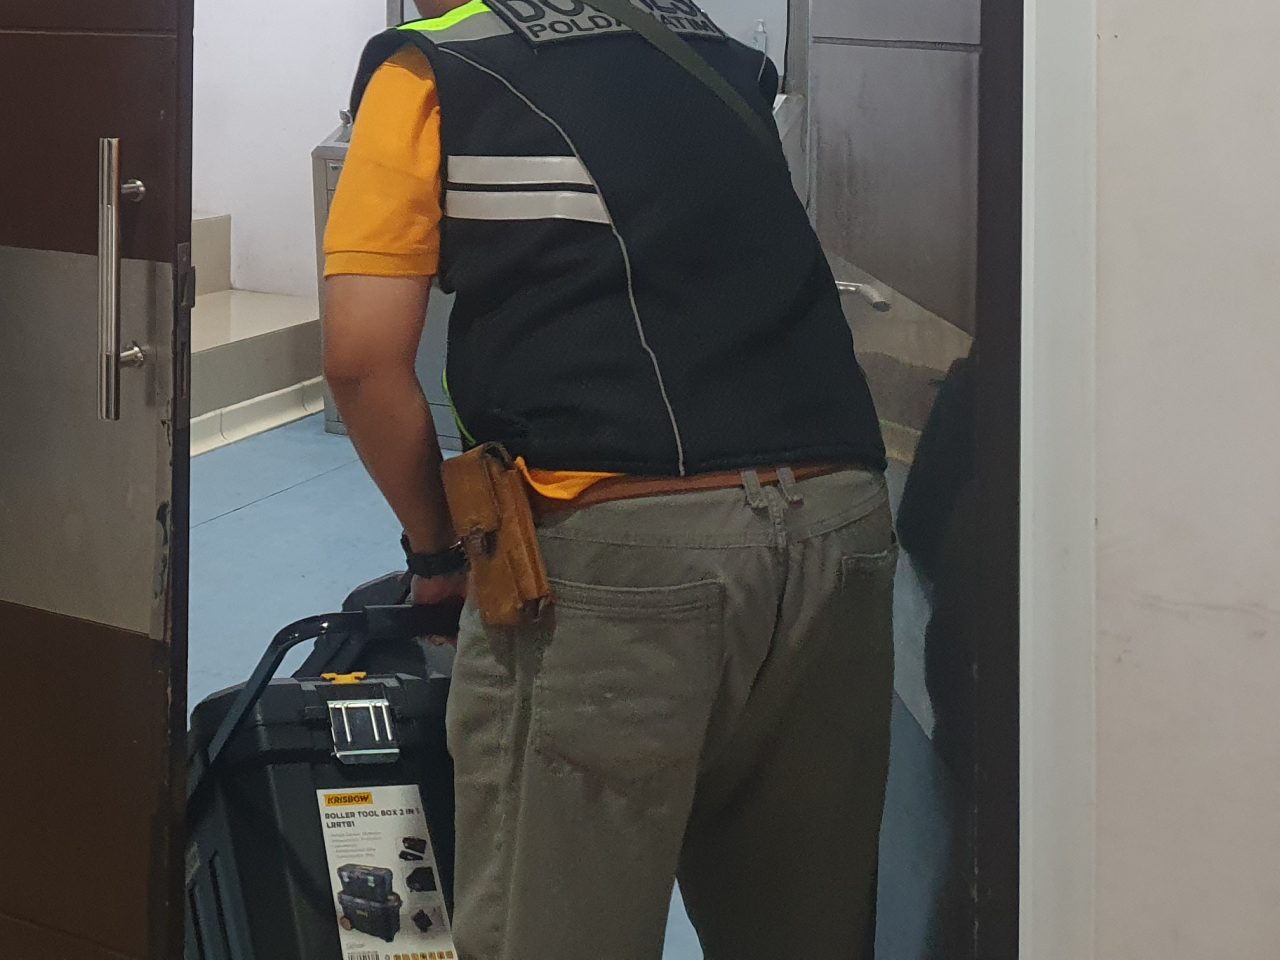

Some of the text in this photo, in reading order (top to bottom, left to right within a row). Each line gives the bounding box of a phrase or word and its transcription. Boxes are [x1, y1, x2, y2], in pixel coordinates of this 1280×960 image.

[526, 14, 718, 38] POLD ATIM
[327, 794, 370, 805] KRISBOW
[324, 811, 356, 819] ROLLER
[357, 810, 380, 818] TOOL
